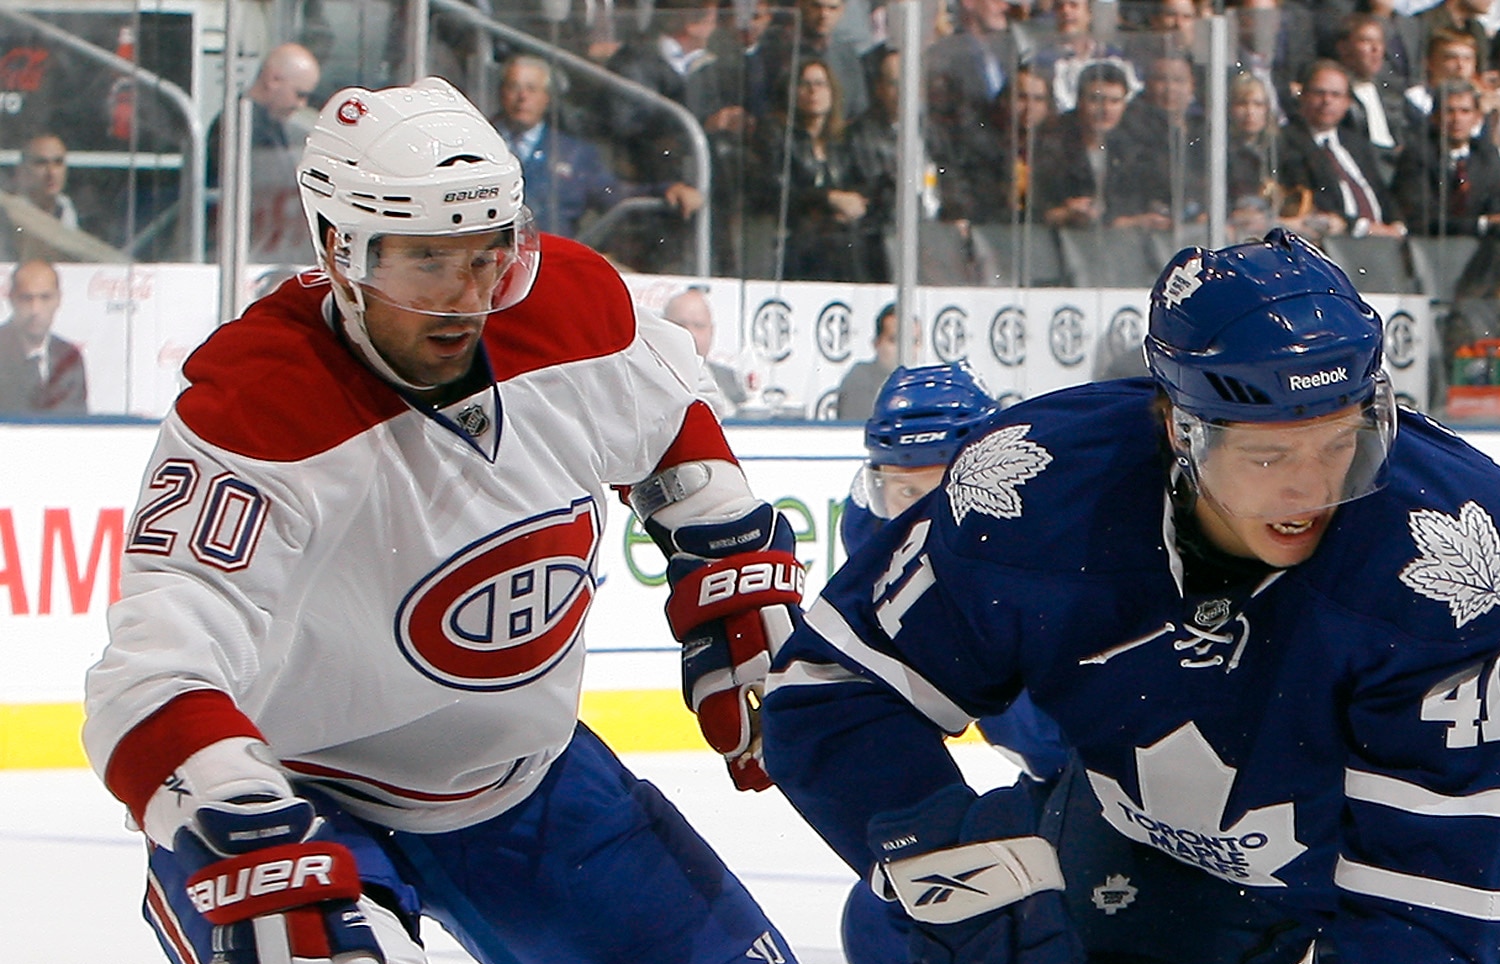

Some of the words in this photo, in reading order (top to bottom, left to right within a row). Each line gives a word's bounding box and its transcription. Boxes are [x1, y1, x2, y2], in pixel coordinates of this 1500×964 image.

[1289, 366, 1348, 392] Reebok
[900, 430, 948, 446] CCM
[126, 457, 271, 572] 20
[872, 519, 937, 640] 41
[1117, 801, 1269, 850] TORONTO
